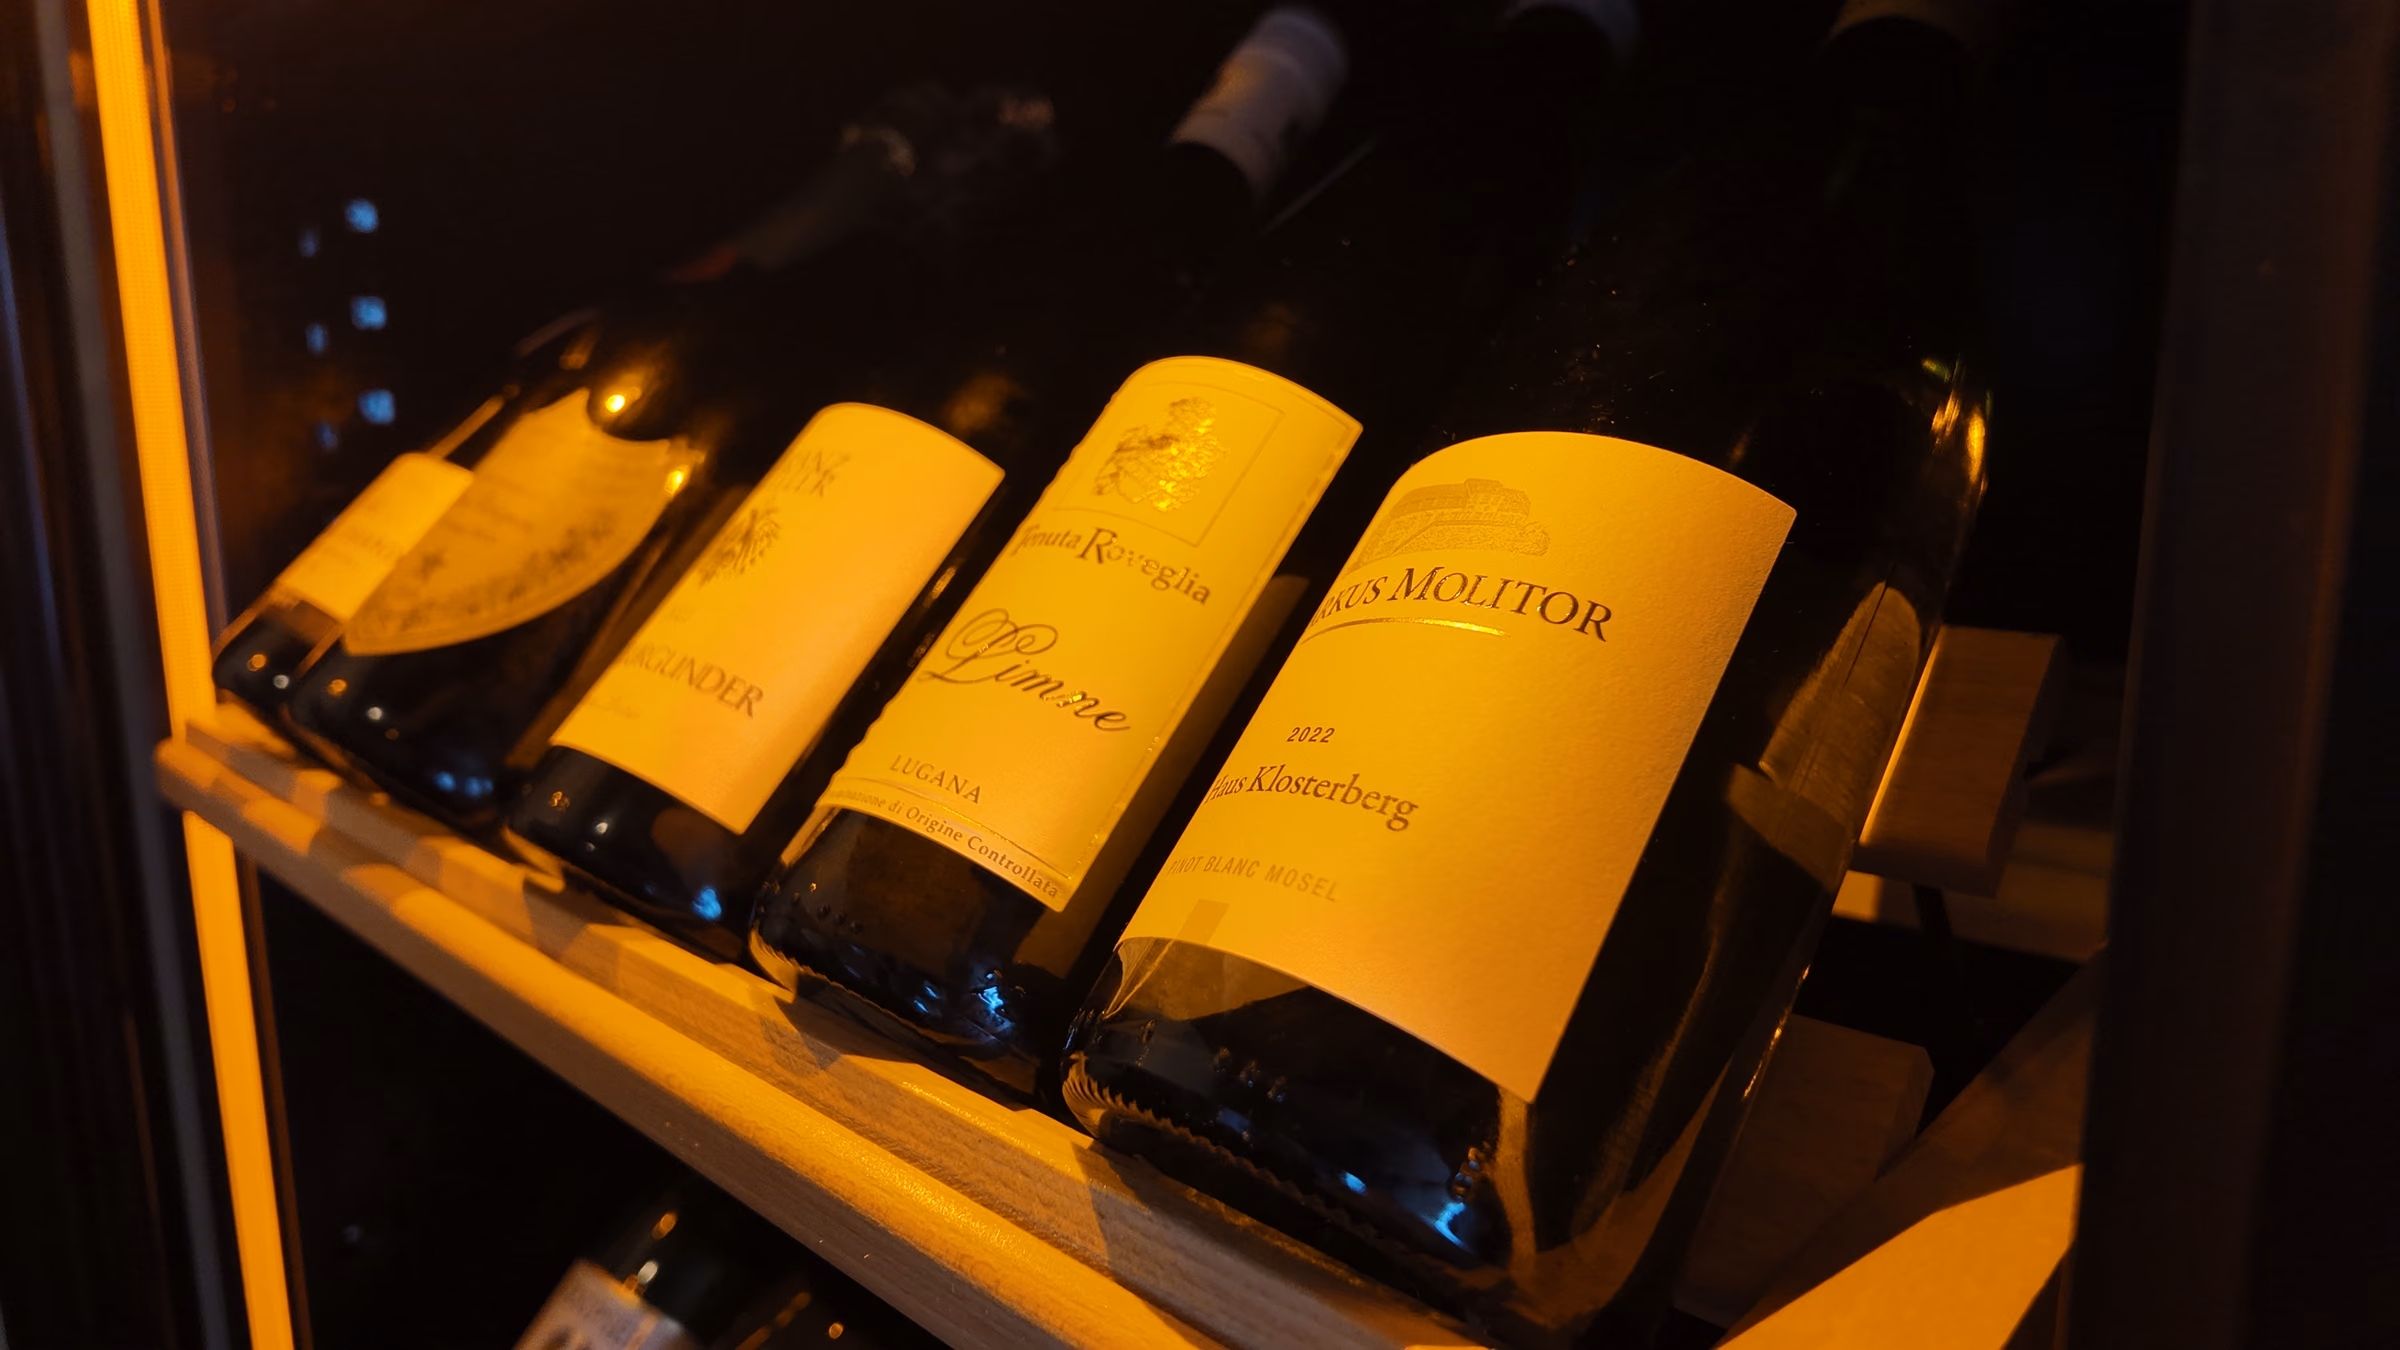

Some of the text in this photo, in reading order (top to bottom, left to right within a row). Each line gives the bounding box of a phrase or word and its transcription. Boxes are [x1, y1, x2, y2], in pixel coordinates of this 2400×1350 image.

[1075, 527, 1210, 605] Roveglia
[1386, 566, 1614, 642] MOLITOR
[918, 607, 1131, 732] Limne
[1287, 726, 1335, 744] 2022
[890, 755, 982, 804] LUGANA
[1246, 764, 1419, 831] Klosterberg
[889, 799, 903, 814] di
[906, 806, 963, 841] Origine
[967, 835, 1059, 900] Controllata
[1203, 856, 1260, 878] BLANC
[1264, 864, 1338, 902] MOSEL
